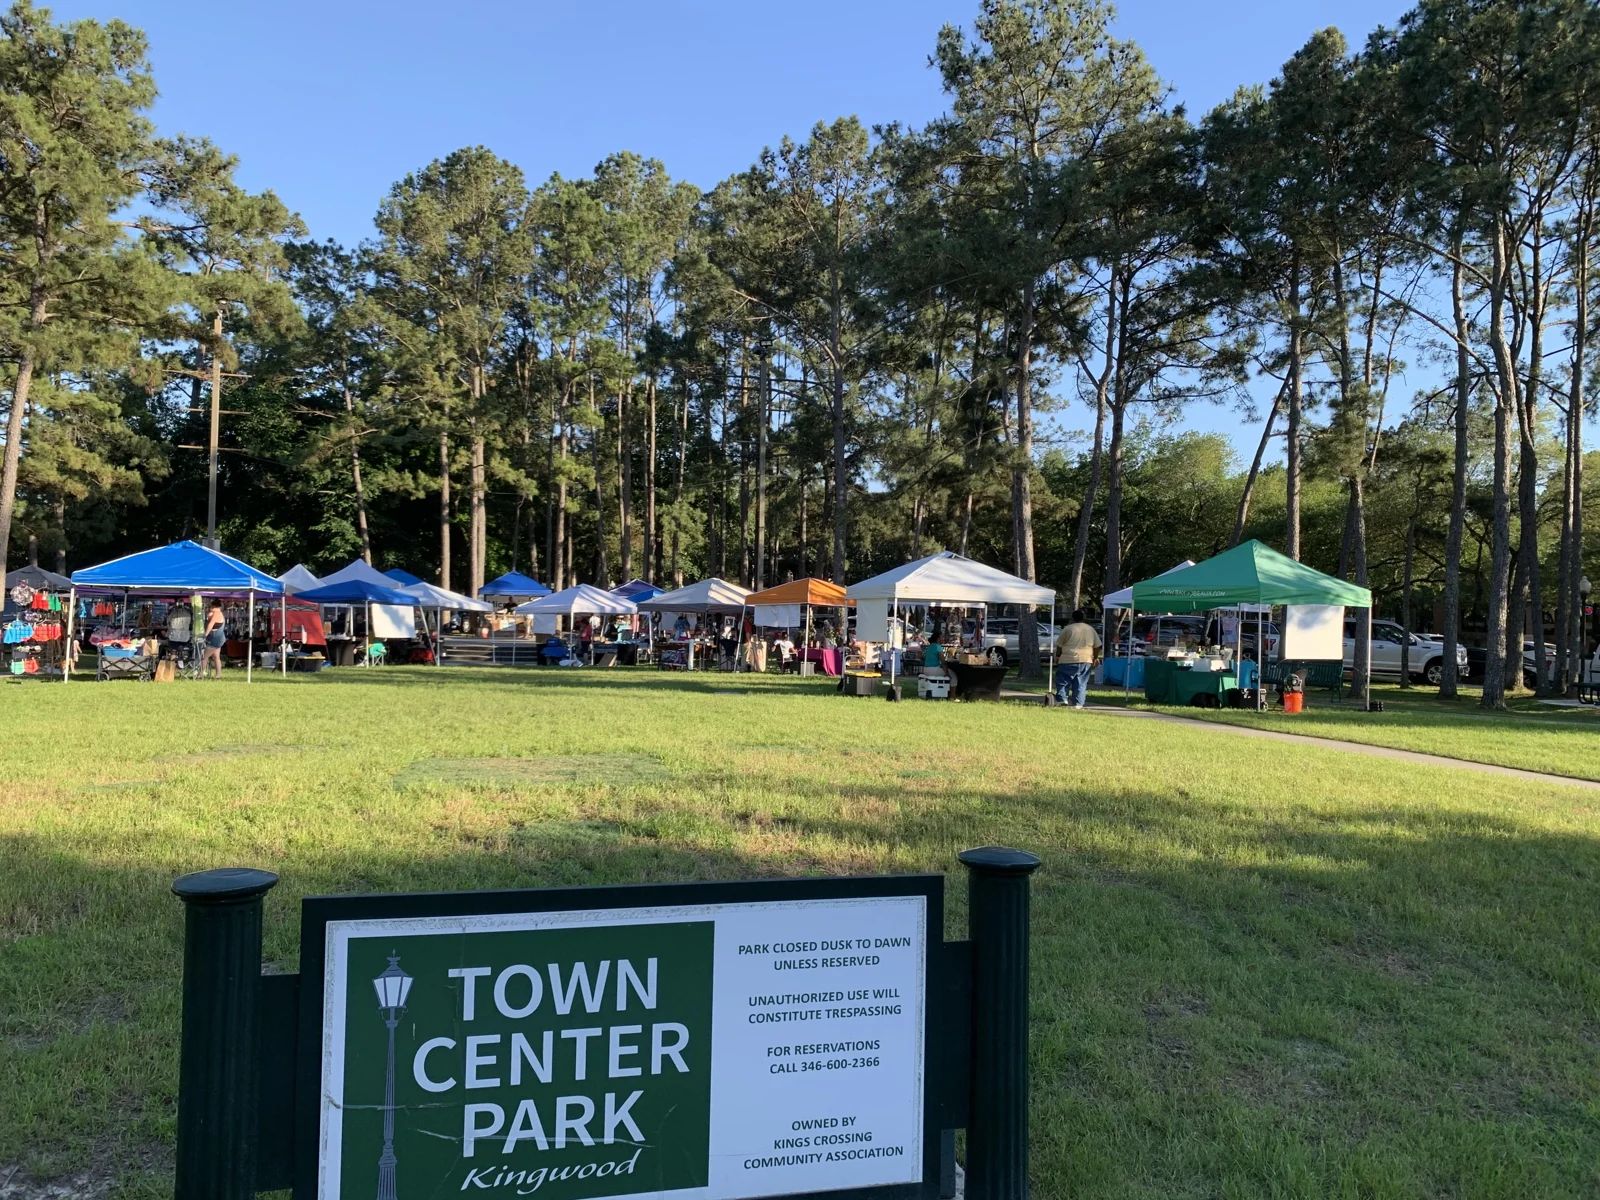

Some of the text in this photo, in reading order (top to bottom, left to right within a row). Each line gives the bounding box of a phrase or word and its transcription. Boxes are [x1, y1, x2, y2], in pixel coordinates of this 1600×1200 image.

[738, 936, 911, 955] PARK CLOSED DUSK TO DAWN
[774, 955, 880, 971] UNLESS RESERVED
[448, 957, 658, 1021] TOWN
[748, 988, 900, 1007] UNAUTHORIZED USE WILL
[748, 1004, 902, 1024] CONSTITUTE TRESPASSING
[412, 1022, 690, 1093] CENTER
[767, 1039, 881, 1058] FOR RESERVATIONS
[769, 1056, 880, 1075] CALL 346-600-2366
[462, 1090, 646, 1158] PARK
[791, 1116, 857, 1131] OWNED BY
[773, 1131, 873, 1150] KINGS CROSSING
[743, 1145, 904, 1170] COMMUNITY ASSOCIATION
[460, 1148, 643, 1195] Kingwood
